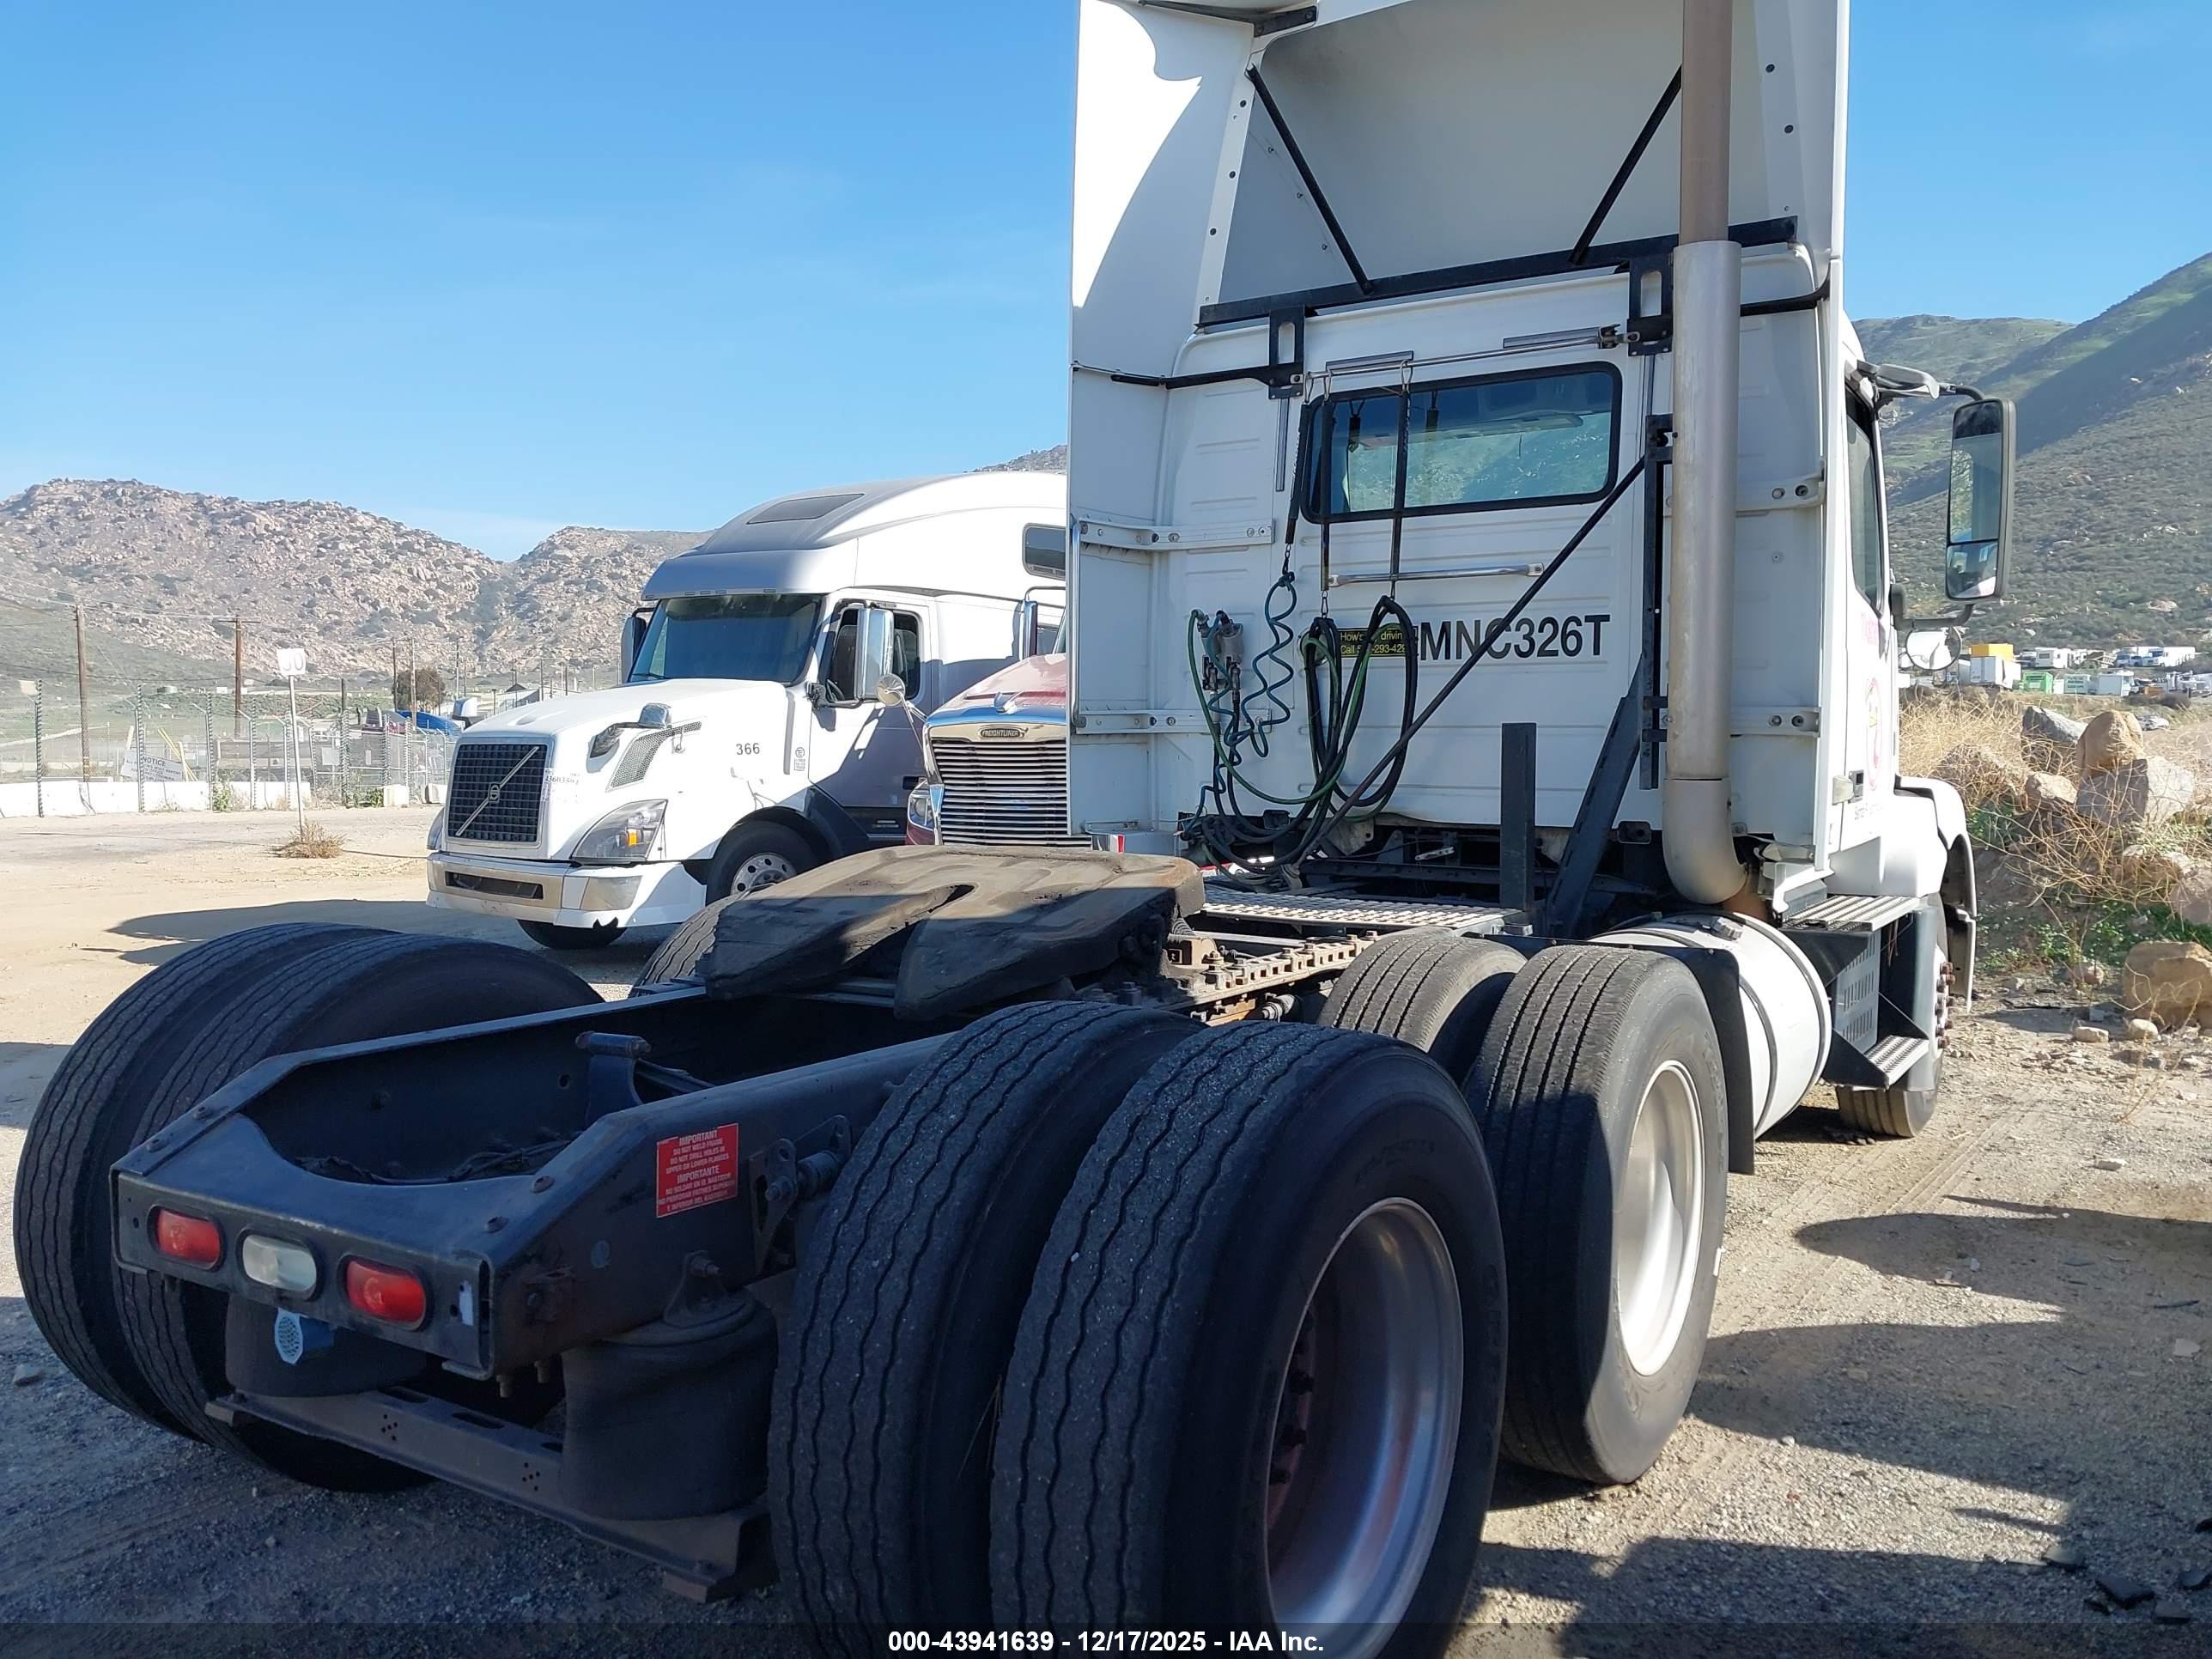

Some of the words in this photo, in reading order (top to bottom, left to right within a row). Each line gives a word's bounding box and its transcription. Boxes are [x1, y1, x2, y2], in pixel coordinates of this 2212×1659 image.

[1420, 615, 1610, 660] MNC326T
[1340, 645, 1355, 654] Call
[736, 743, 760, 755] 366
[142, 756, 166, 766] NOTICE
[679, 1130, 716, 1145] IMPORTANT
[678, 1165, 719, 1182] IMPORTANTE
